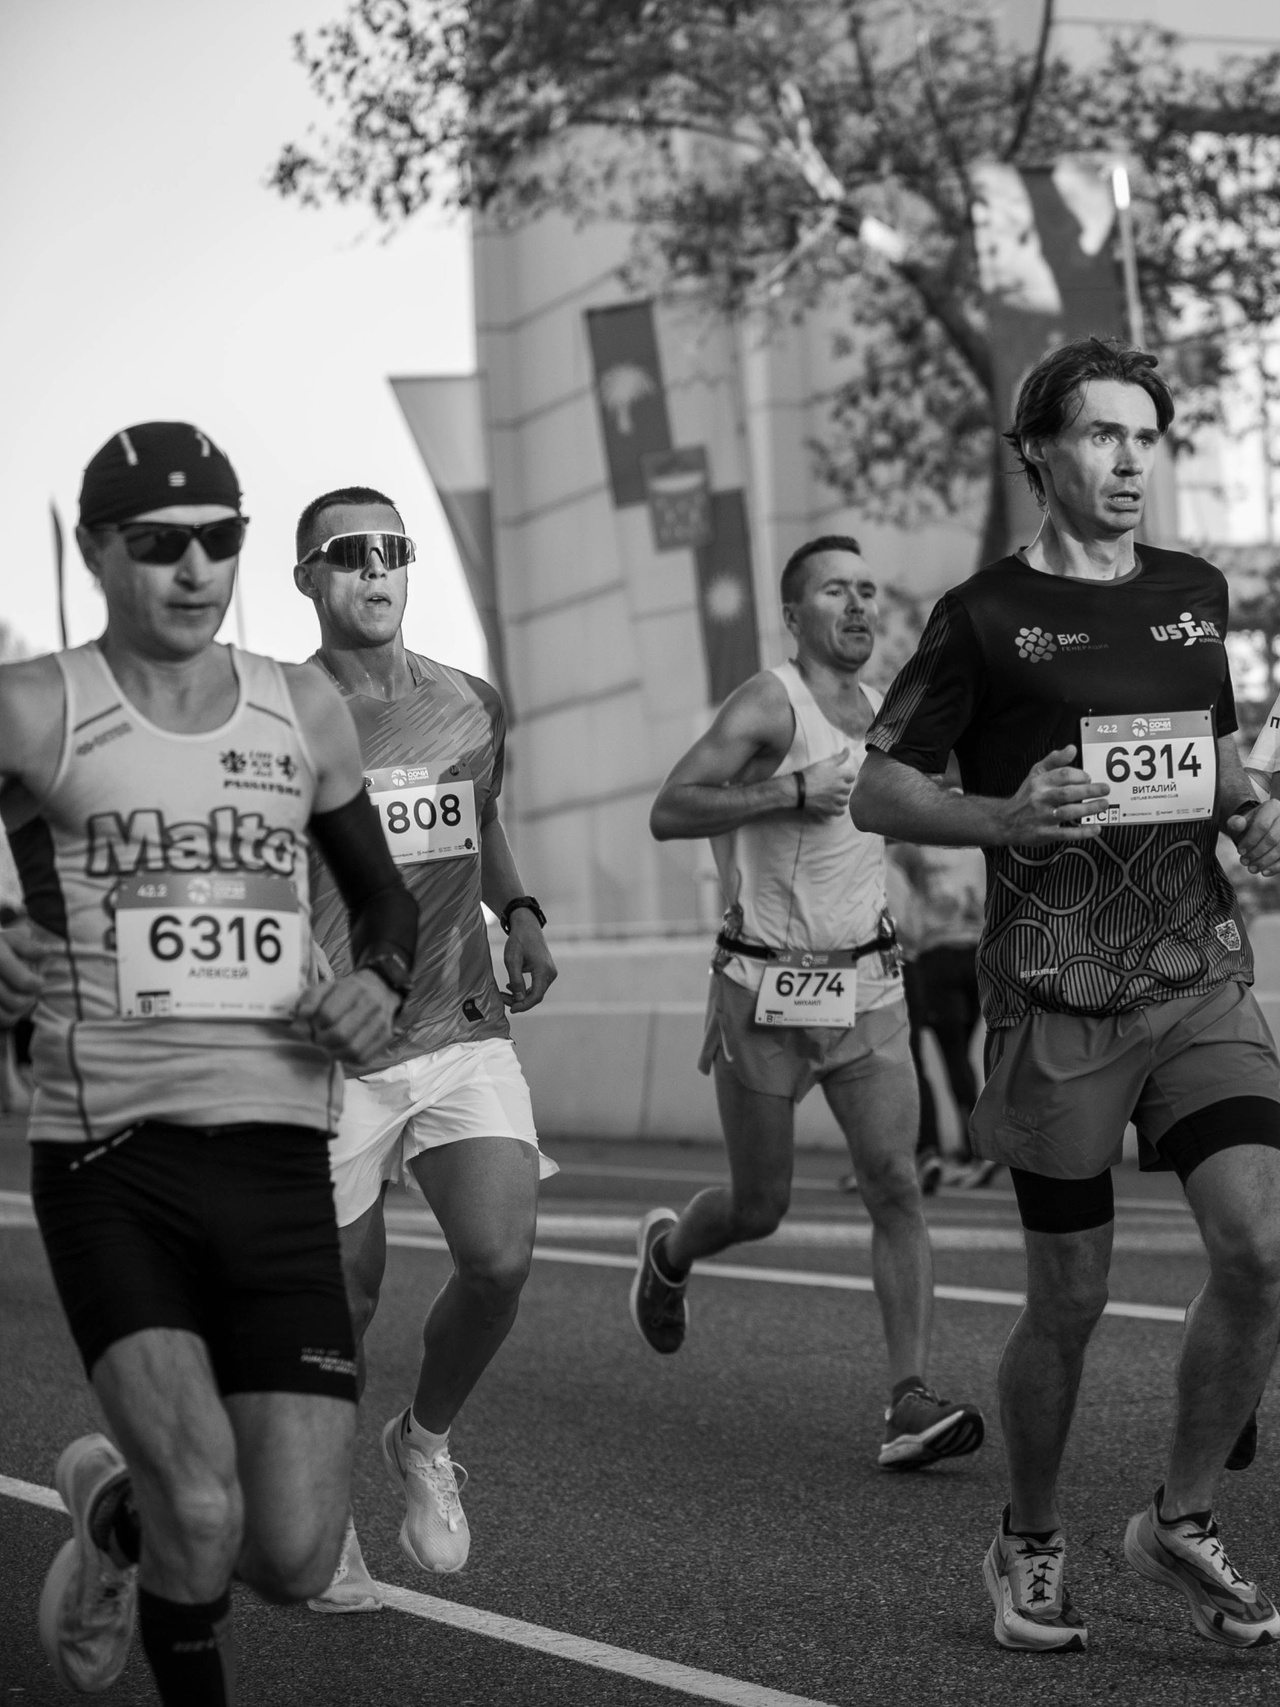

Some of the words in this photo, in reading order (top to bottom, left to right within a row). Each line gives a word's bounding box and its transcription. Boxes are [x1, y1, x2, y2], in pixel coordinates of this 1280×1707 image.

[1057, 632, 1090, 646] БИО
[1096, 724, 1118, 734] 42.2
[1148, 720, 1171, 729] СОЧИ
[1106, 742, 1202, 783] 6314
[407, 769, 429, 778] СОЧИ
[1132, 781, 1177, 794] ВИТАЛИЙ
[373, 794, 462, 834] 808
[1096, 811, 1107, 821] C
[149, 914, 282, 964] 6316
[188, 965, 249, 980] АЛЕКСЕЙ
[775, 971, 845, 998] 6774
